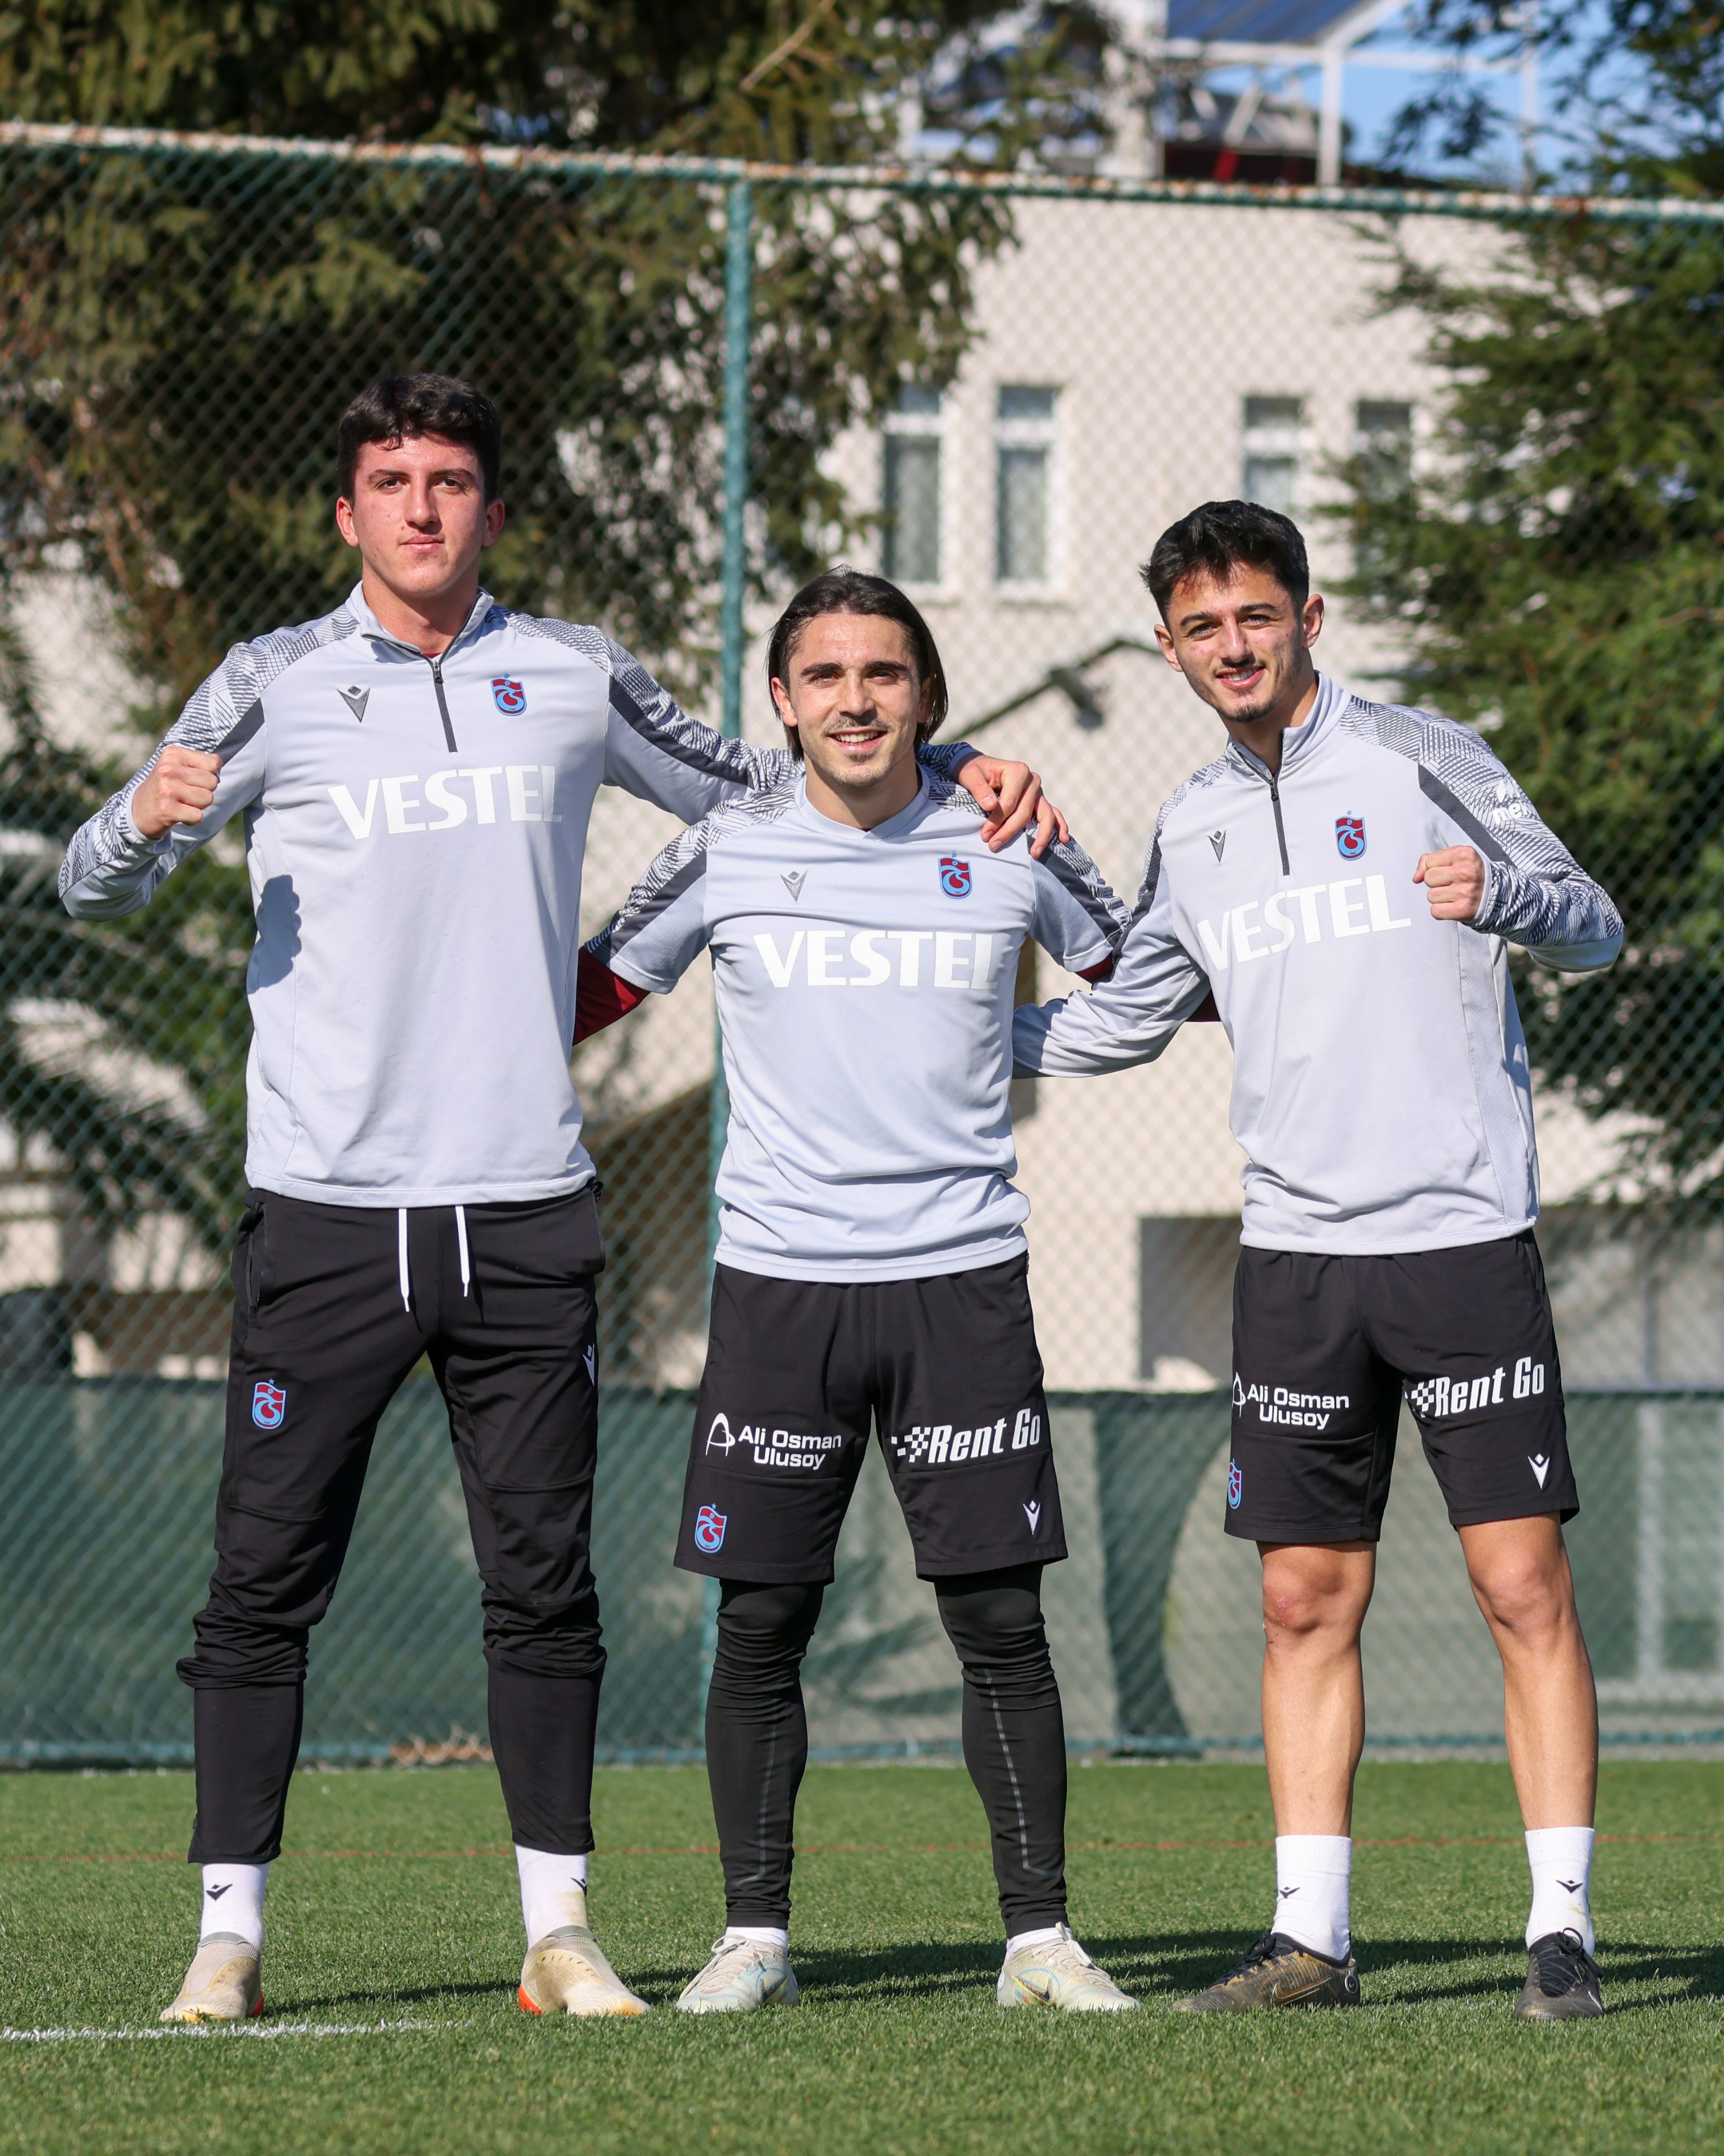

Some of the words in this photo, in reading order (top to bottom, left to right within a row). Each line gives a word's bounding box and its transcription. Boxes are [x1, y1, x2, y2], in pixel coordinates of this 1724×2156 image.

[327, 765, 563, 840] VESTEL
[1197, 874, 1412, 972] VESTEL
[753, 930, 998, 989] VESTEL
[1247, 1384, 1268, 1403] Ali
[1274, 1388, 1349, 1409] Osman
[1434, 1366, 1507, 1417] Rent
[1512, 1356, 1545, 1399] Go
[738, 1425, 766, 1445] Ali
[772, 1430, 841, 1449] Osman
[928, 1418, 1007, 1463] Rent
[1011, 1408, 1040, 1450] Go
[1259, 1403, 1330, 1430] Ulusoy
[754, 1446, 826, 1470] Ulusoy
